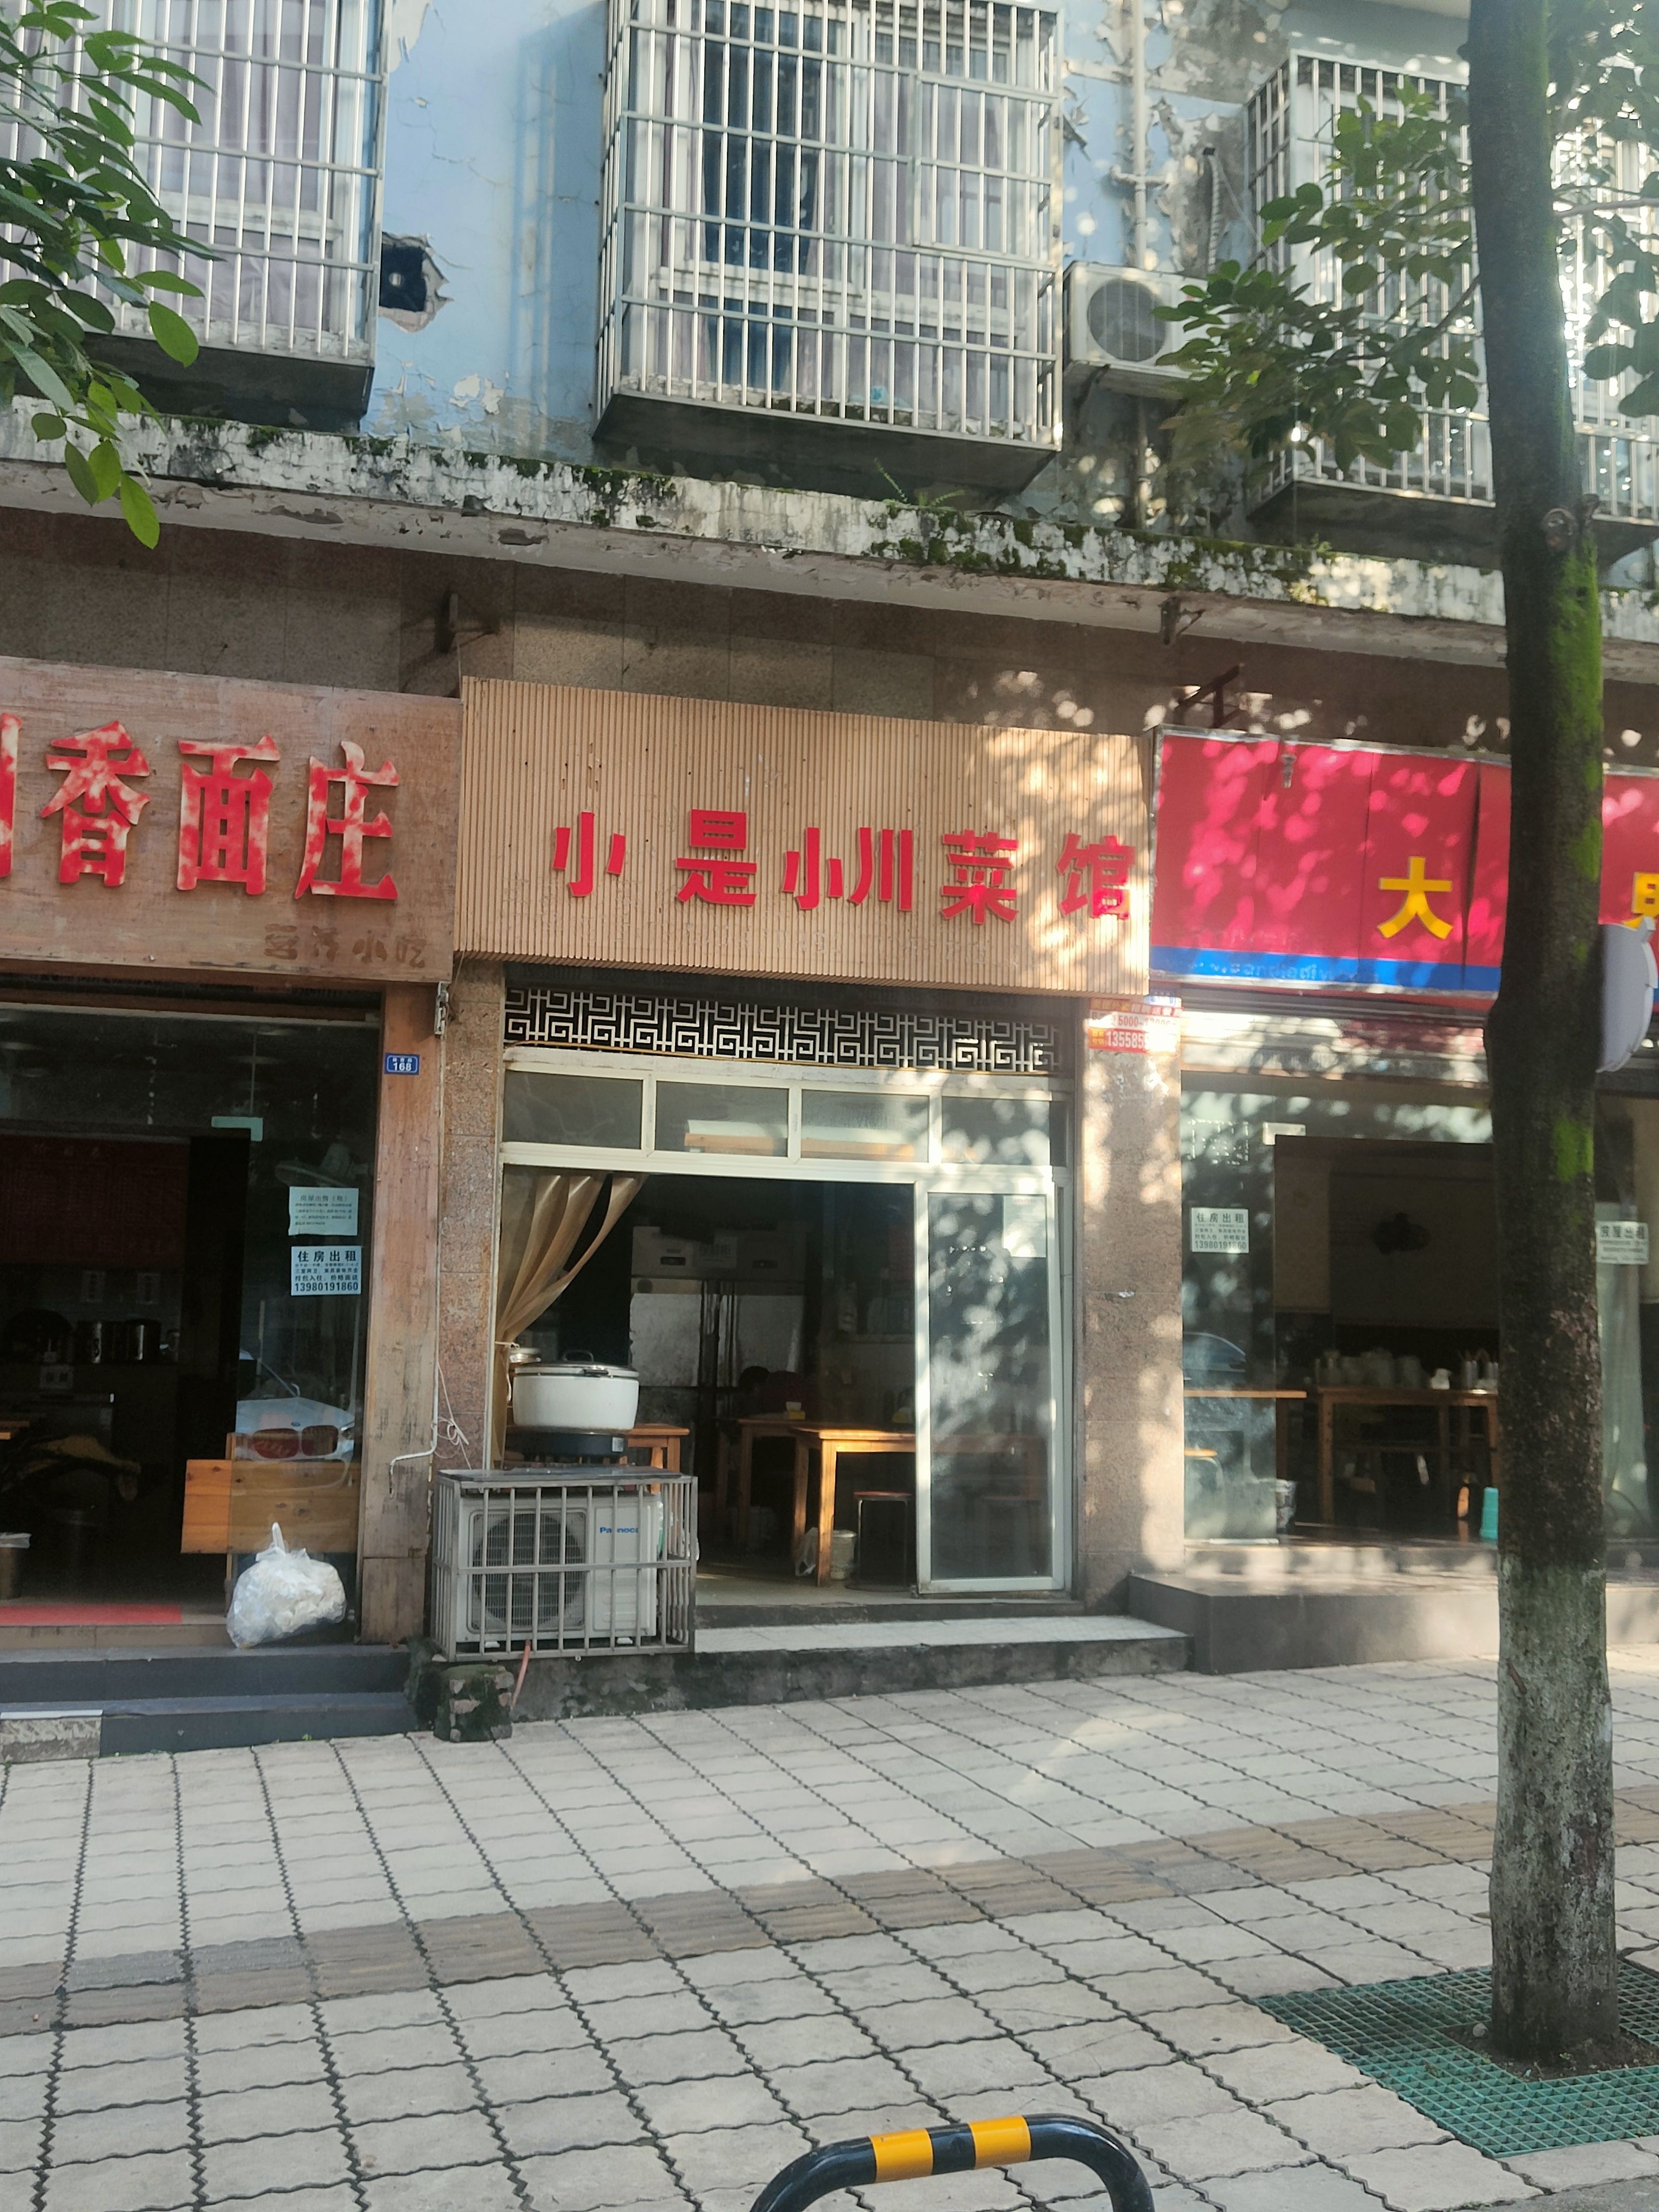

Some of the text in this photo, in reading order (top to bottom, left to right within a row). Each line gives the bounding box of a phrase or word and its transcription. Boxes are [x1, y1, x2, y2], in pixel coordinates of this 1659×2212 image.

[0, 712, 401, 900] 香面庄
[552, 808, 1136, 925] 小是小川菜馆
[1377, 855, 1453, 940] 大
[393, 1062, 412, 1071] 168
[1196, 1213, 1244, 1223] 住房出租
[298, 1250, 356, 1263] 住房出租
[295, 1282, 358, 1291] 13980191860
